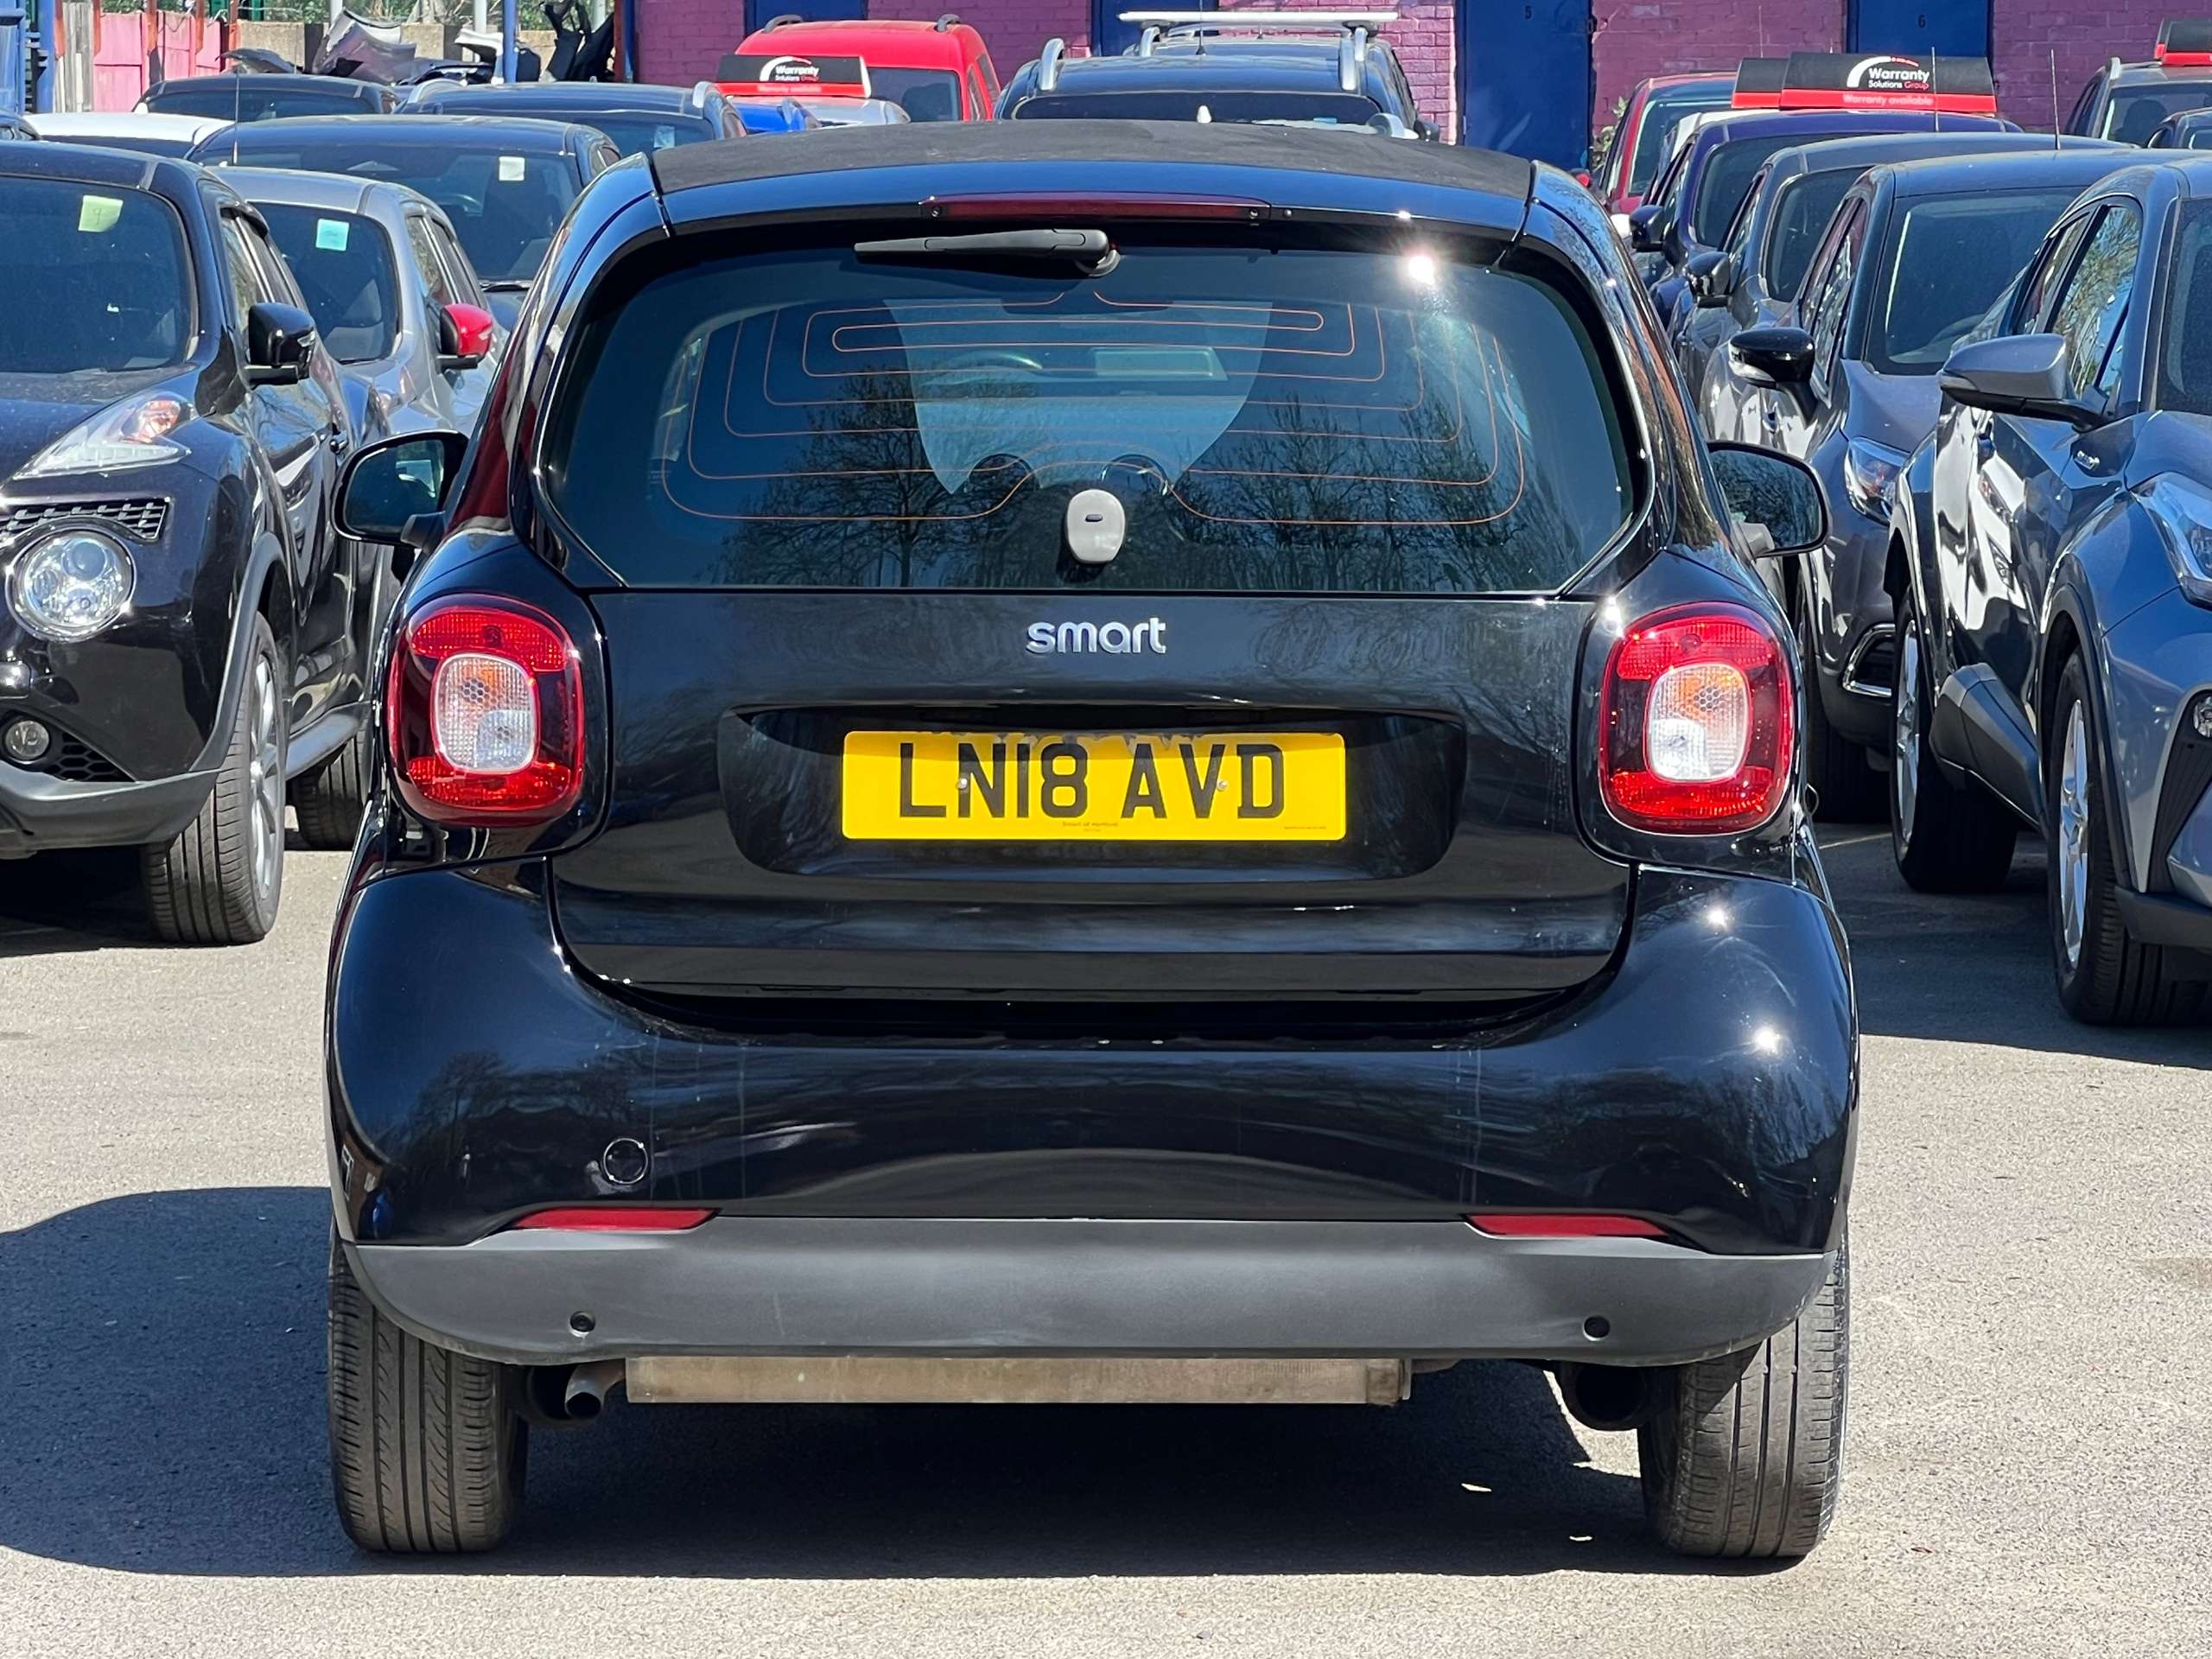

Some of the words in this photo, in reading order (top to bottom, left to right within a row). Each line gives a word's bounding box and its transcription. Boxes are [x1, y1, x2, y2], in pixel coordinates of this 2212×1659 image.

[1524, 5, 1533, 19] 5
[1917, 14, 1926, 28] 6
[775, 65, 820, 76] Warranty
[1868, 67, 1930, 83] Warranty
[1868, 79, 1903, 88] Solutions
[1904, 80, 1929, 90] Group
[1842, 93, 1887, 106] Warranty
[1888, 96, 1934, 106] available
[1027, 617, 1166, 654] smart
[899, 742, 1088, 819] LN18
[1120, 743, 1285, 819] AVD
